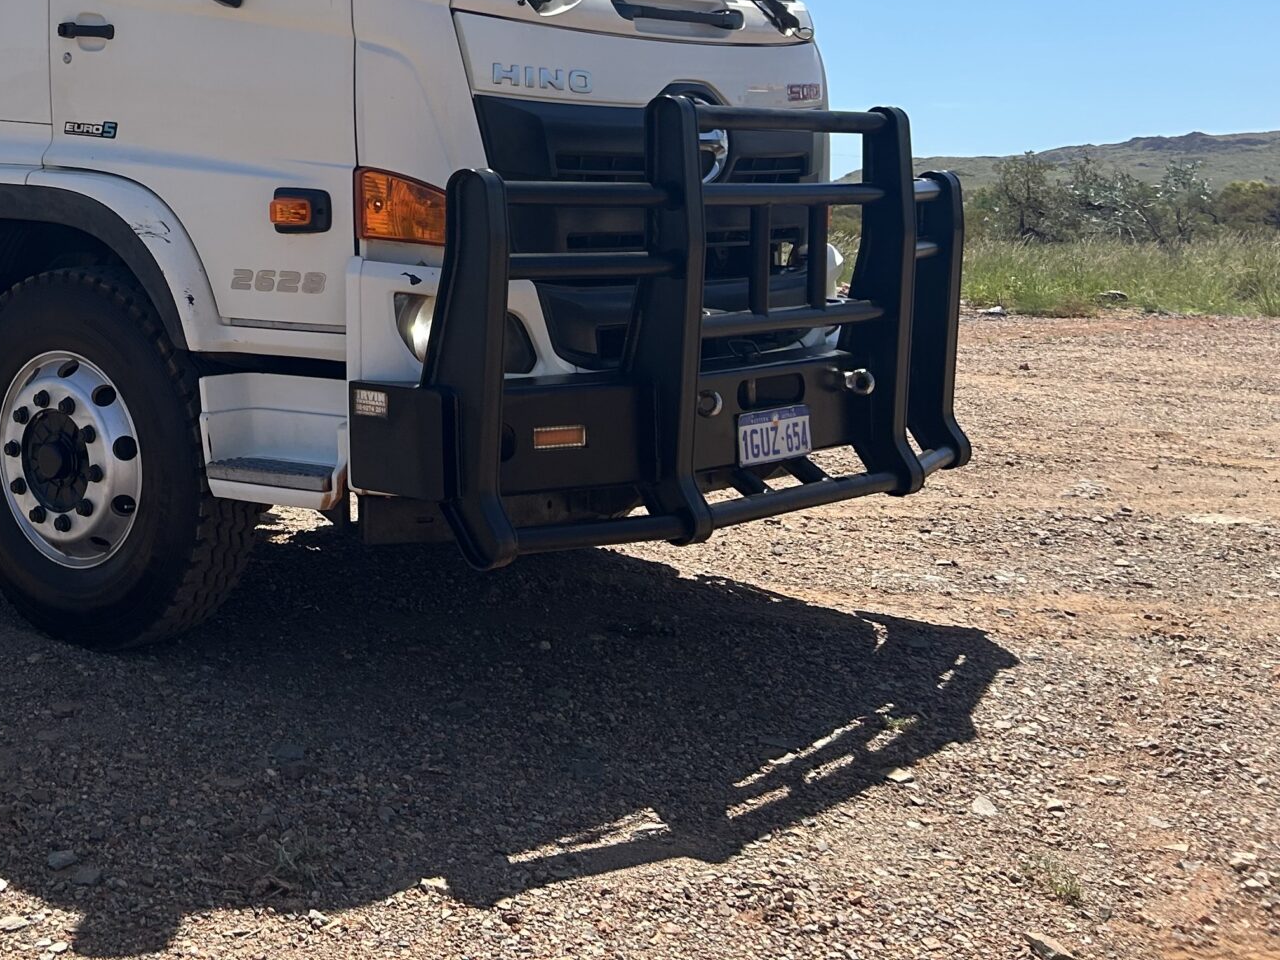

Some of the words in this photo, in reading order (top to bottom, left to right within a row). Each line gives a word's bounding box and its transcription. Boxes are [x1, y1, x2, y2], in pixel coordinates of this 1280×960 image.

[492, 63, 592, 94] HINO
[230, 269, 327, 294] 2628
[356, 390, 386, 403] IRVIN
